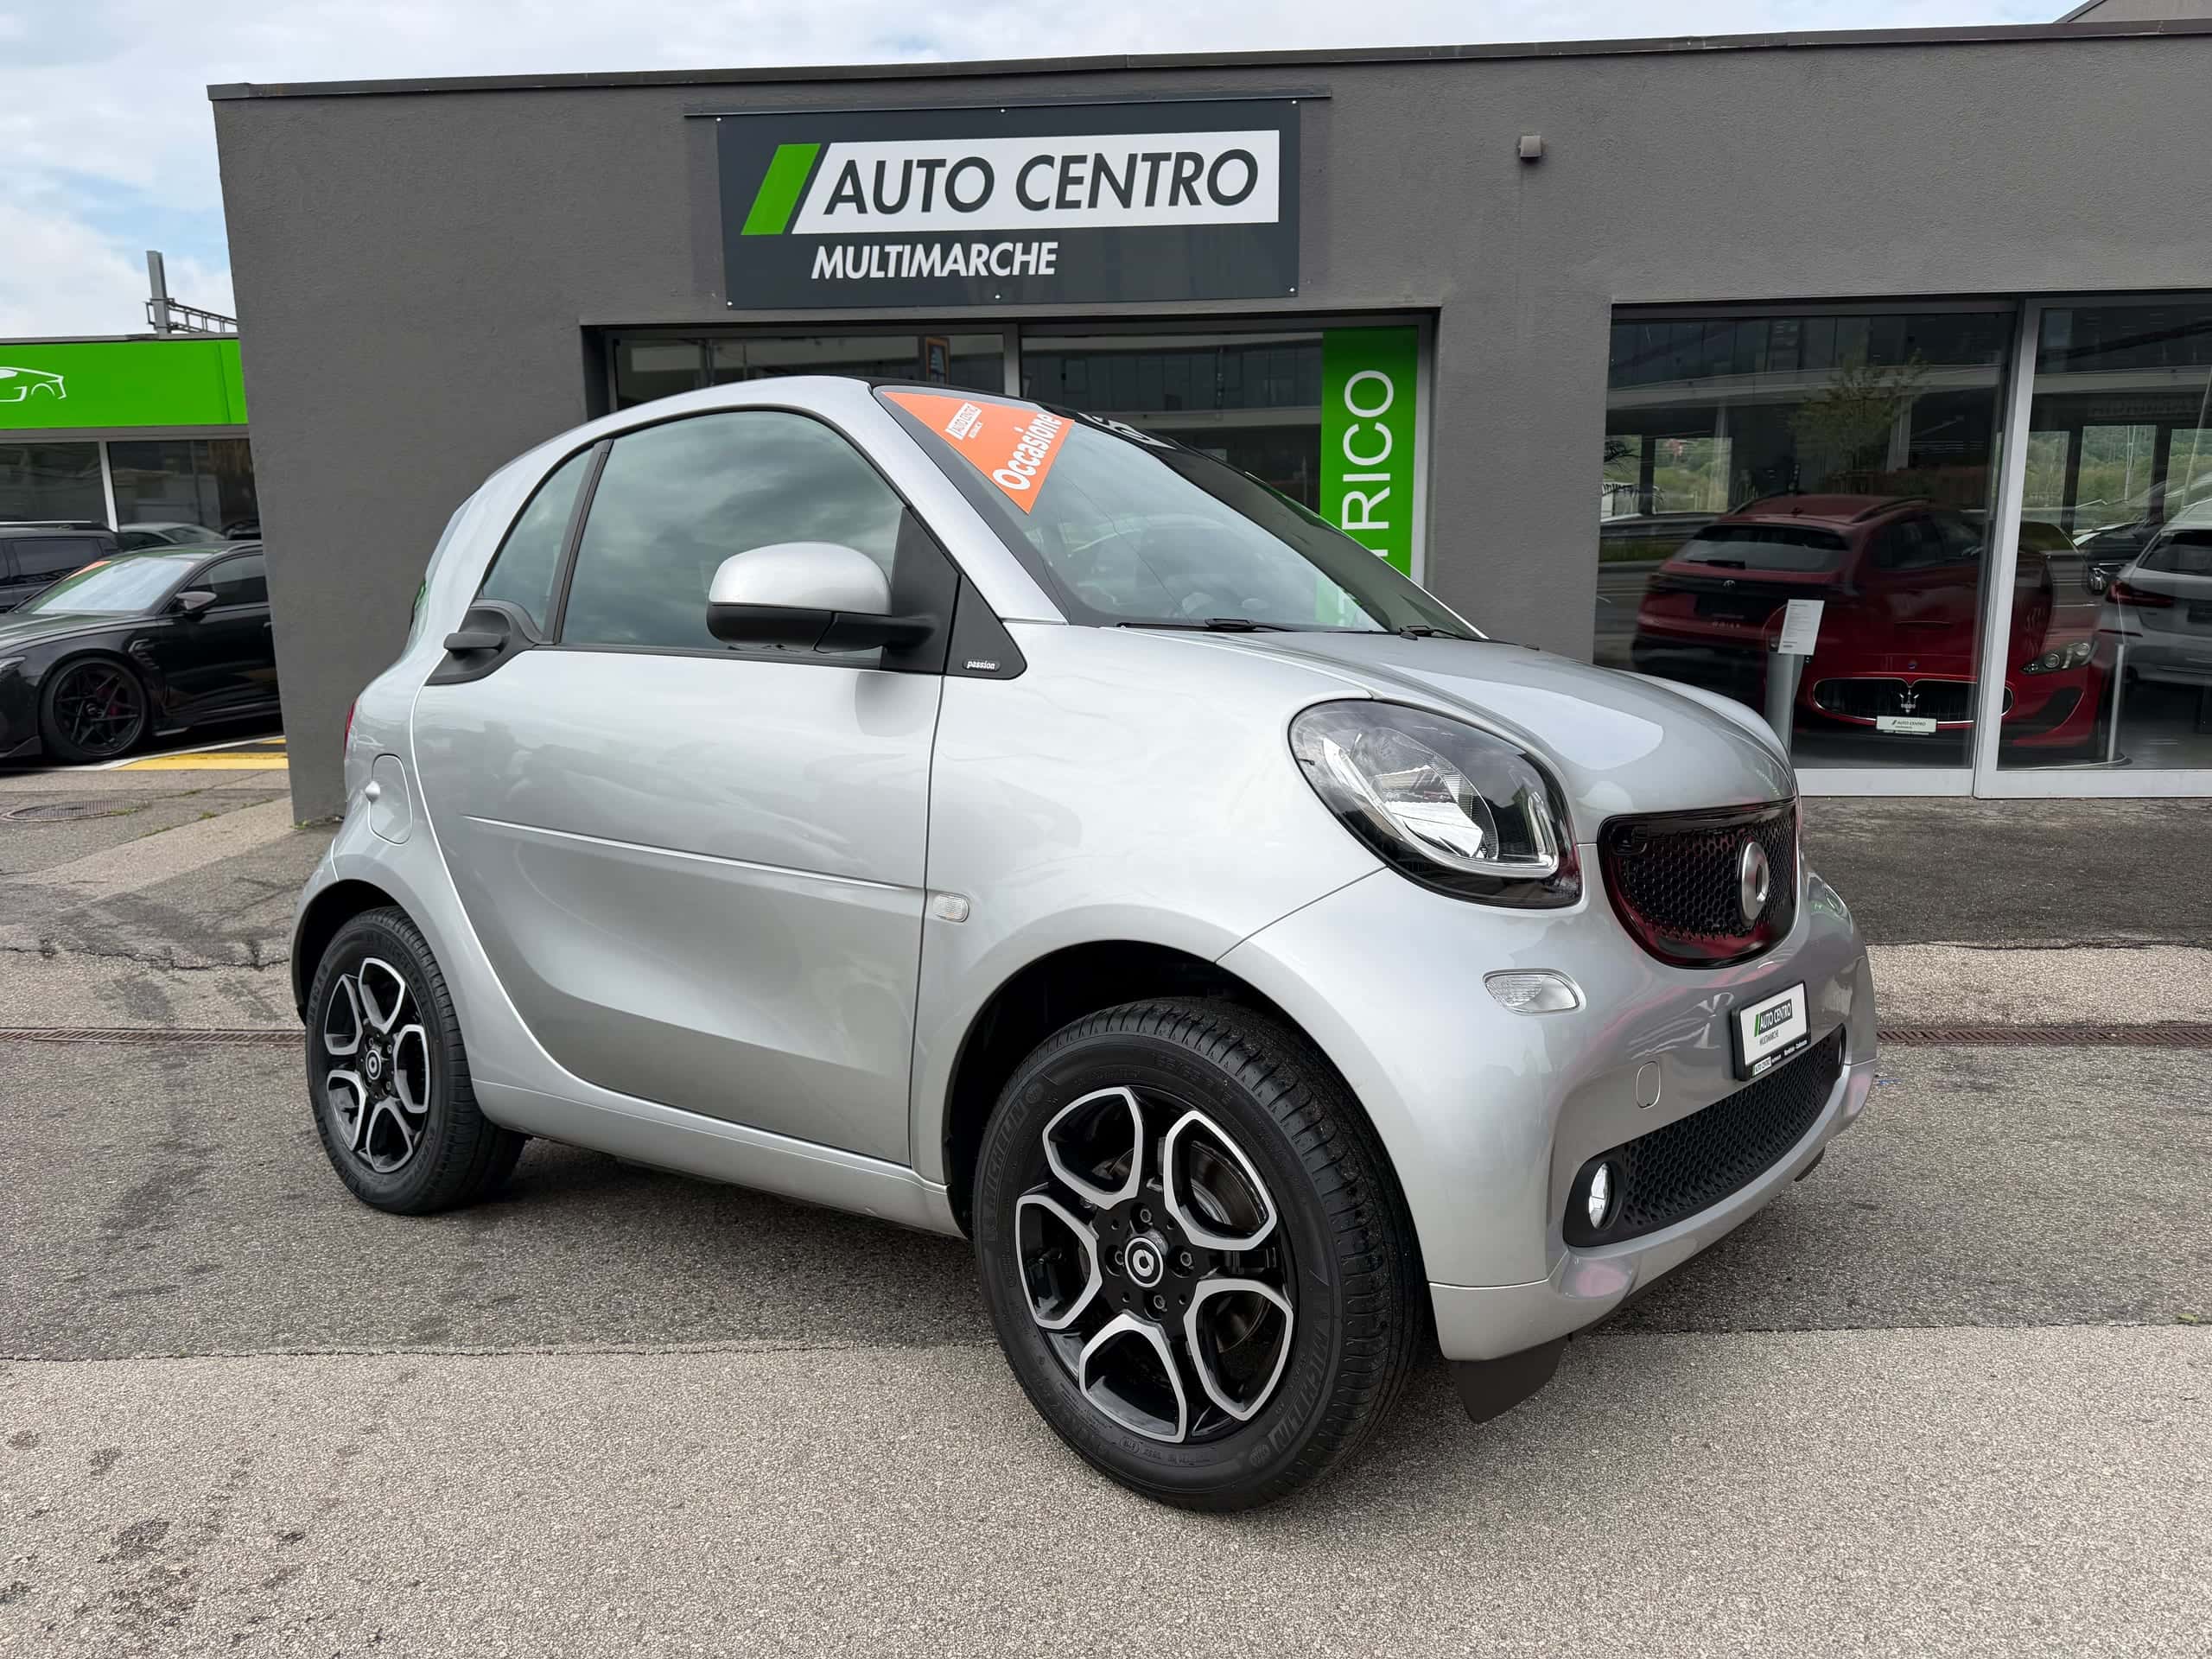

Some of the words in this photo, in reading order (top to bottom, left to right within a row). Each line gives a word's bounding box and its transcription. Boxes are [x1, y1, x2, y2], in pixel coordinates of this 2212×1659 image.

[823, 156, 995, 215] AUTO
[1014, 149, 1258, 212] CENTRO
[810, 242, 1058, 279] MULTIMARCHE
[993, 413, 1063, 490] Occasione
[966, 660, 995, 670] passion
[1759, 1011, 1773, 1031] AUTO
[1774, 1002, 1791, 1024] CENTRO
